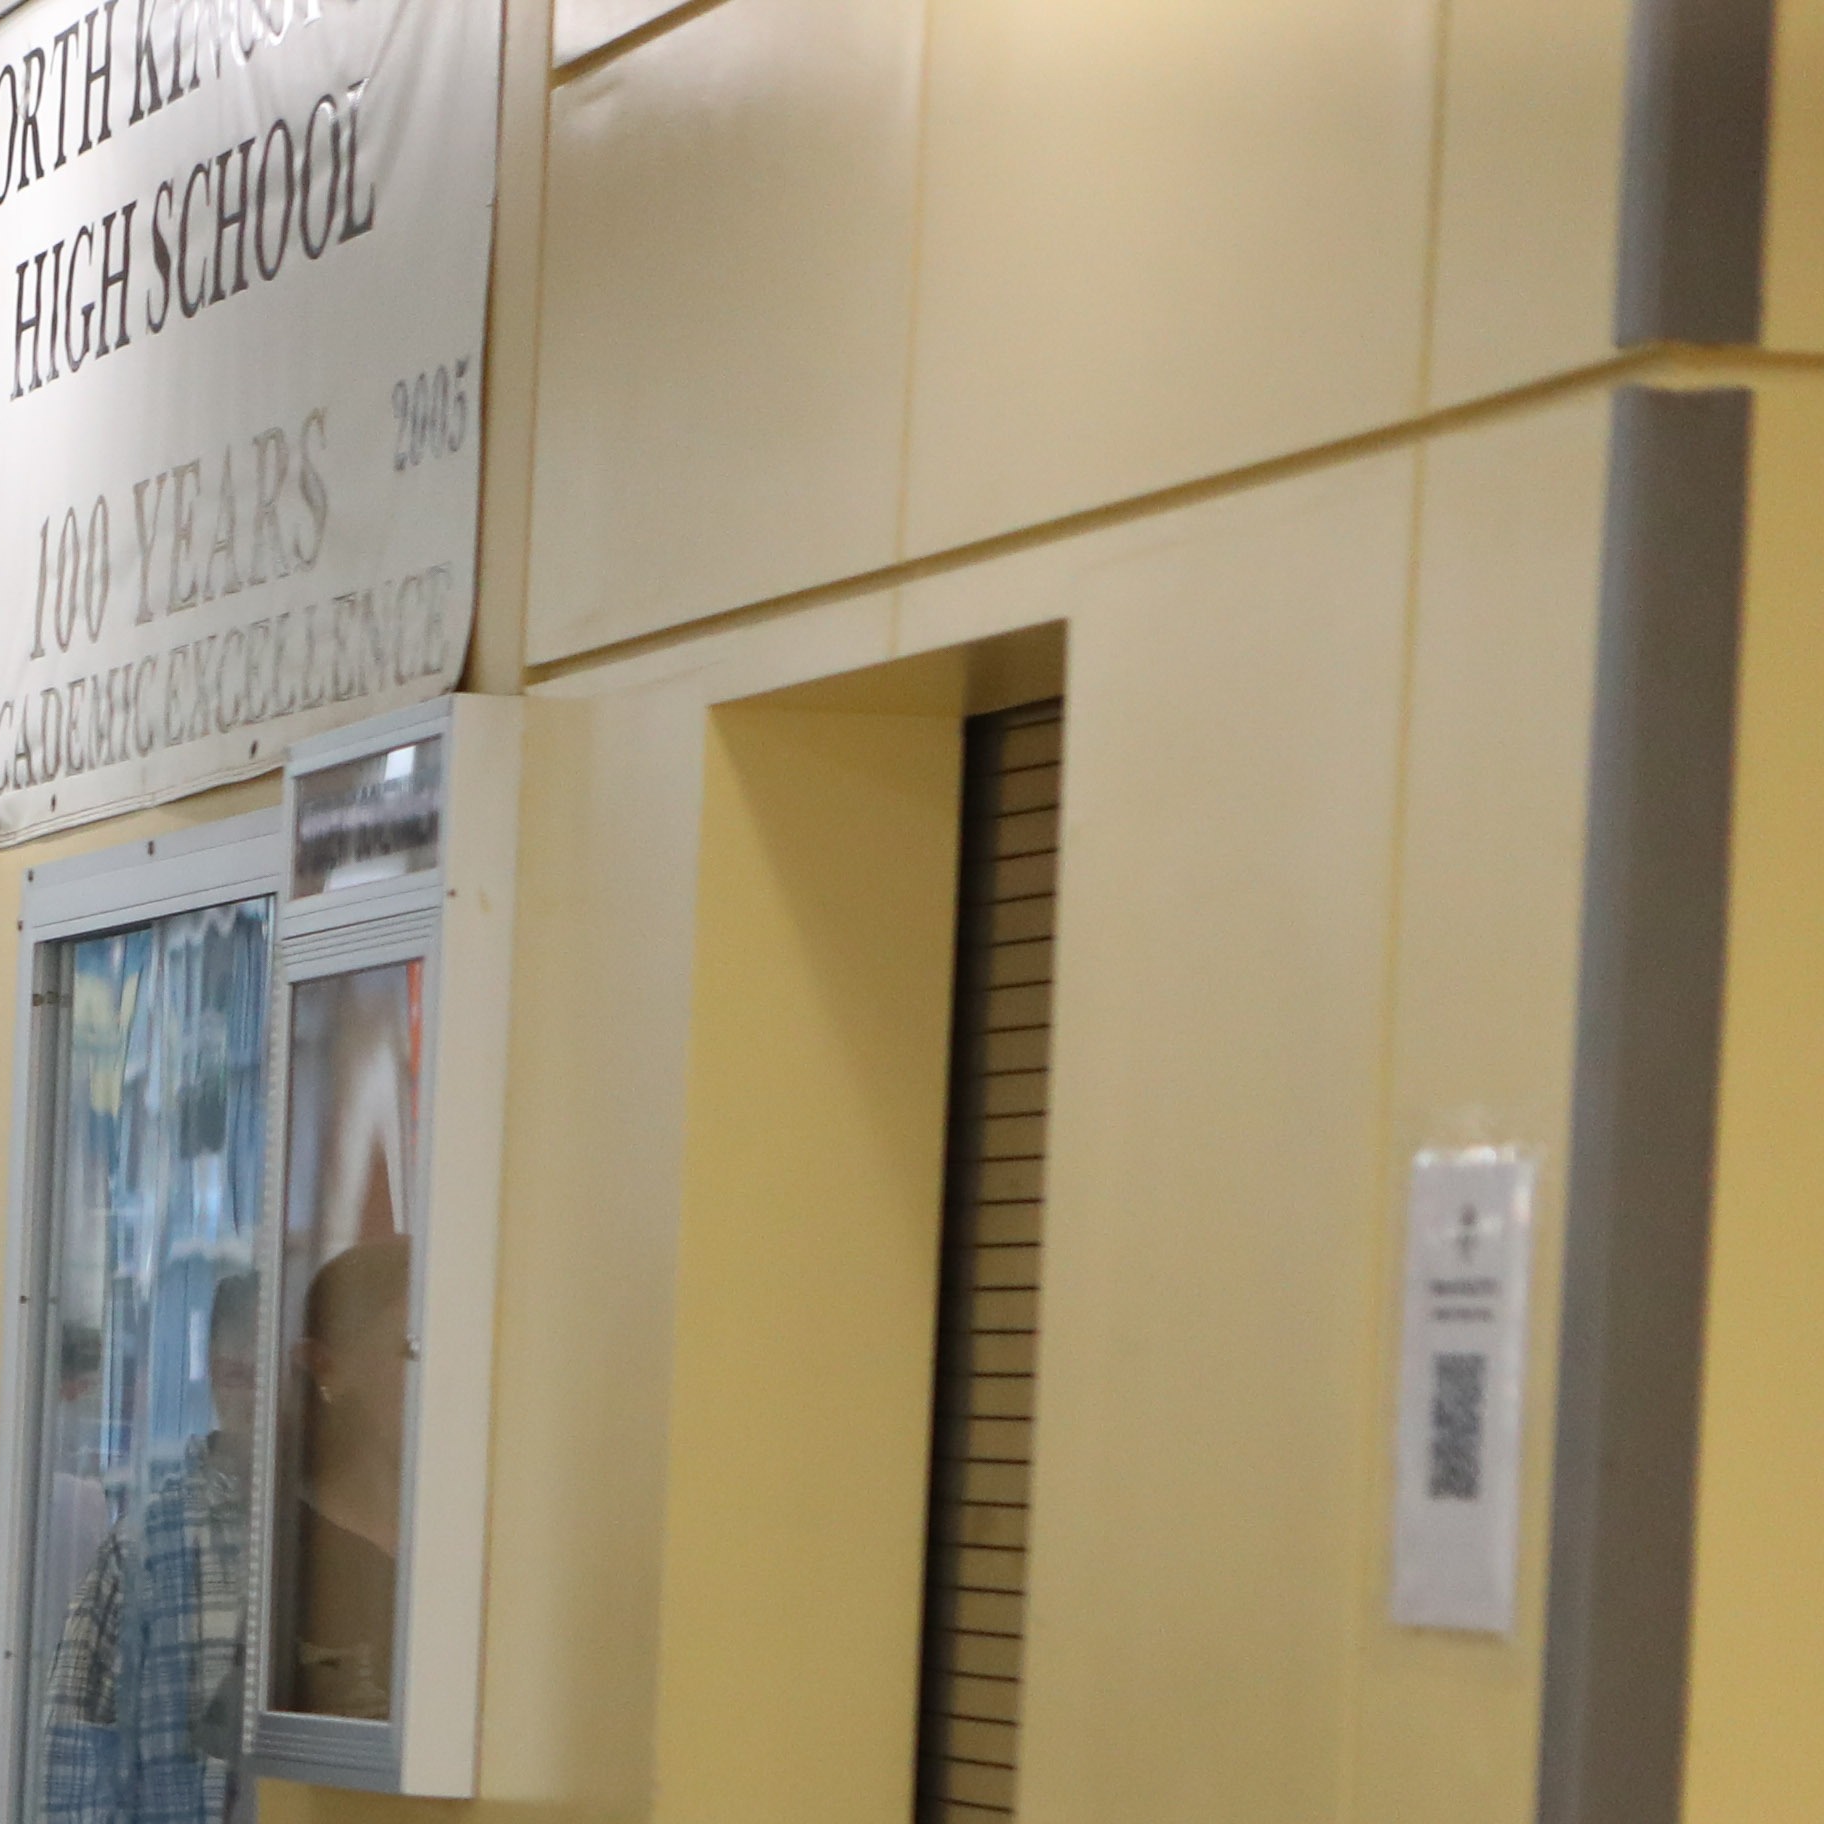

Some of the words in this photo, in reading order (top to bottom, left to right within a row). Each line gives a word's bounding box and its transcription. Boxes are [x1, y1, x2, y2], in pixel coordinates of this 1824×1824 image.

[9, 200, 138, 401] HIGH
[146, 78, 376, 335] SCHOOL
[29, 494, 110, 660] 100
[133, 406, 330, 627] YEARS
[391, 357, 470, 472] 2005
[163, 560, 452, 748] EXCELLENCE
